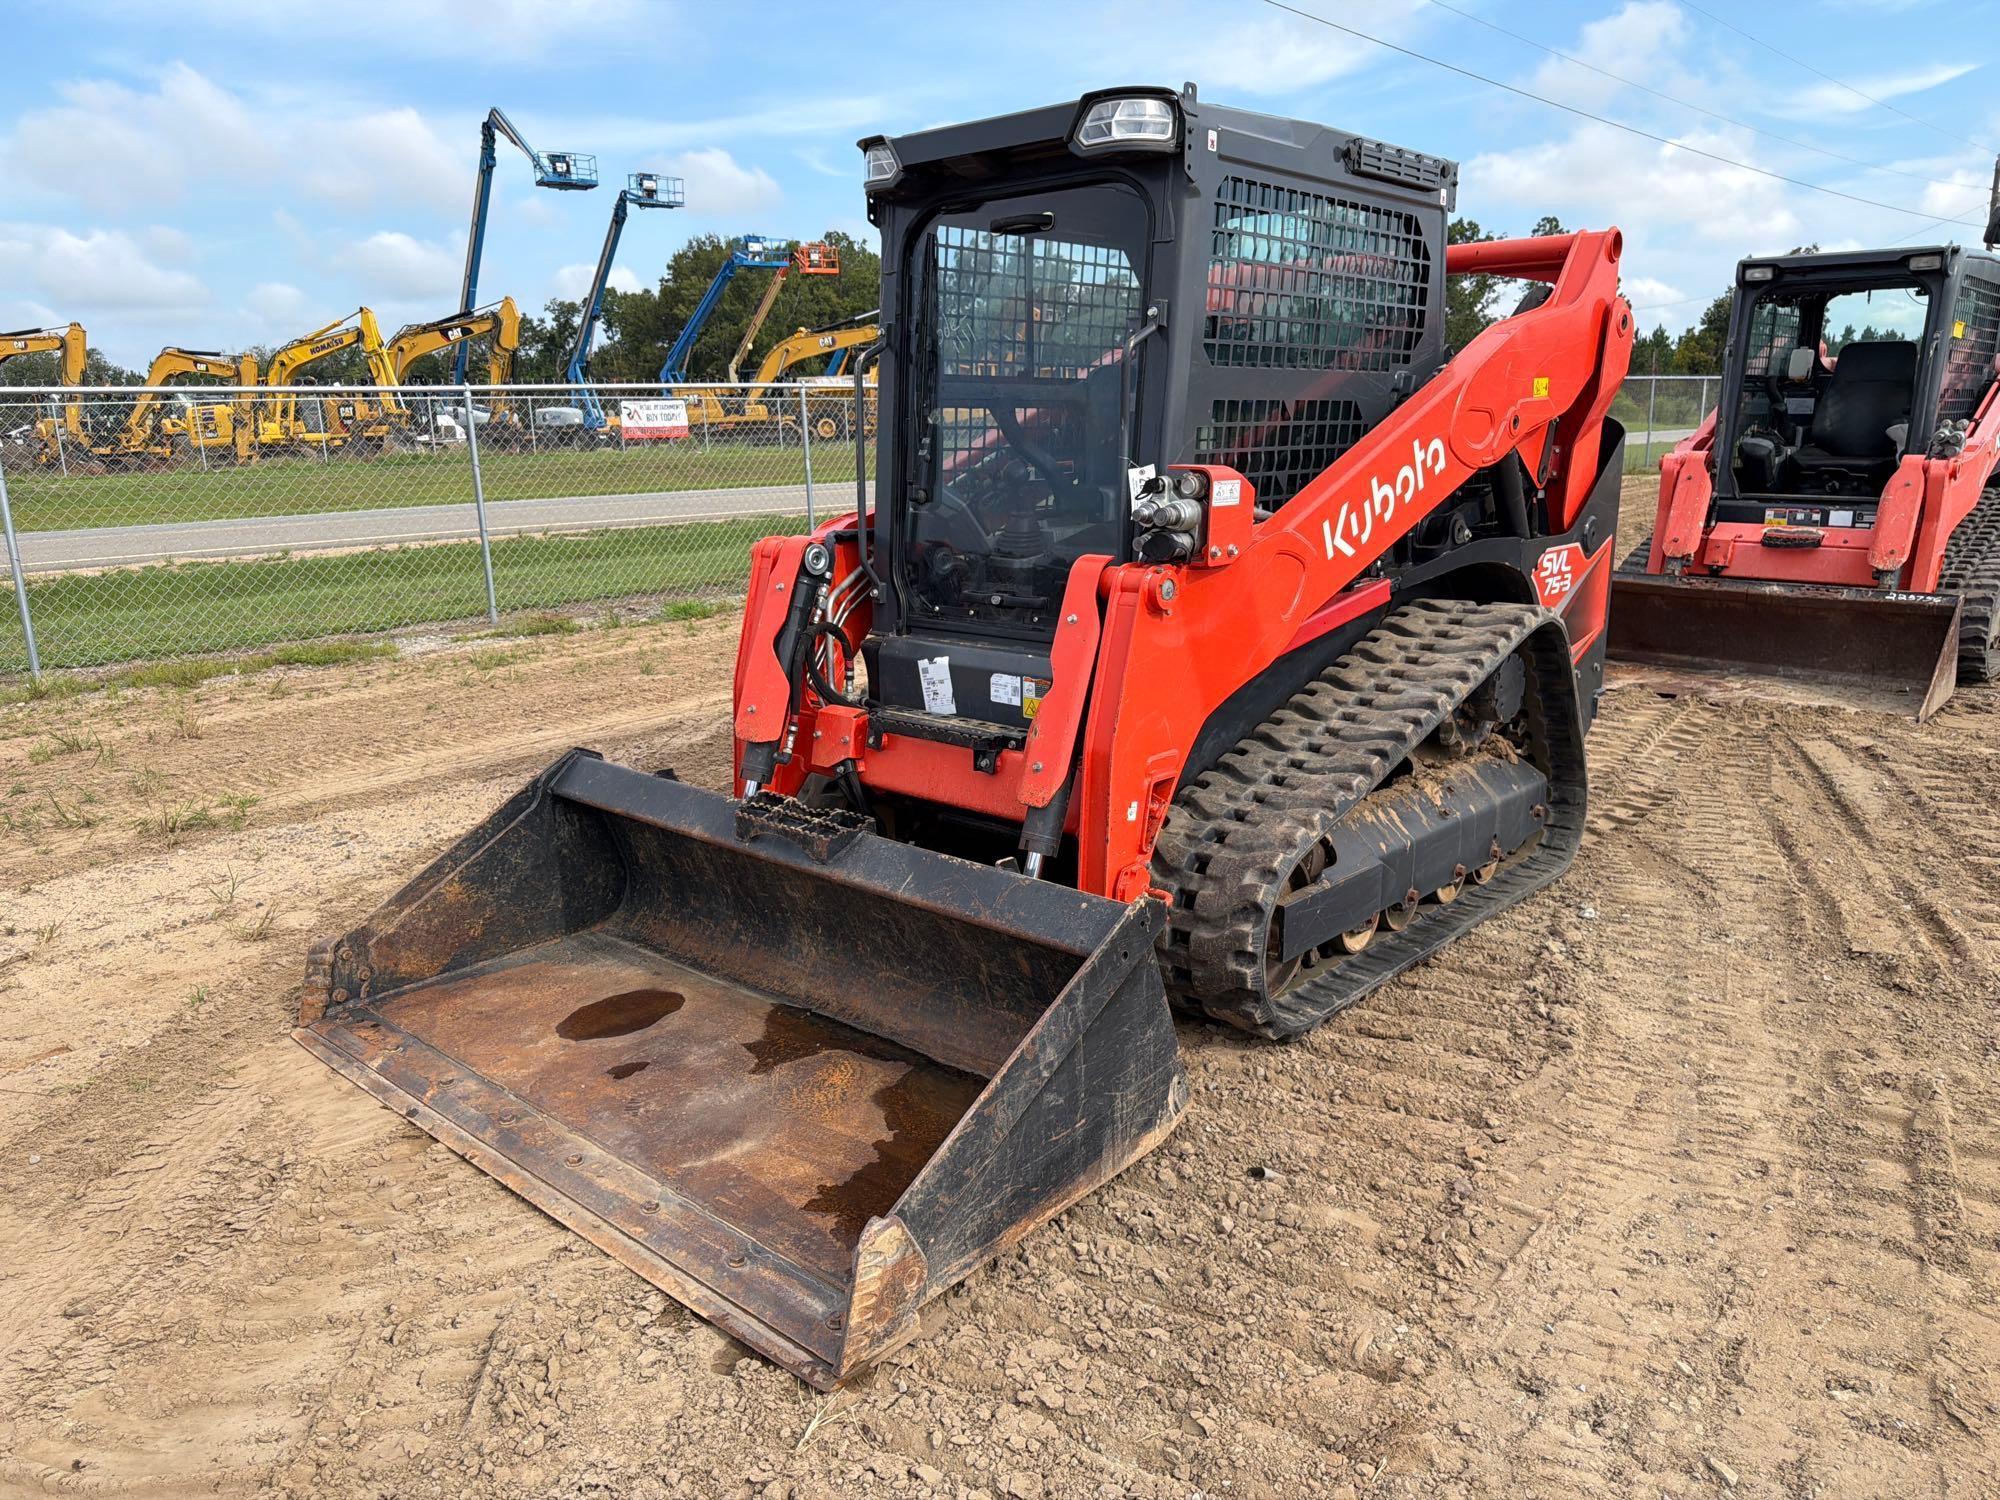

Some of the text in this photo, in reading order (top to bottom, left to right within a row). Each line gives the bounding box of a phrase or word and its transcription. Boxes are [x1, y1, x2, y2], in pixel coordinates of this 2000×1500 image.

[448, 327, 463, 340] CAT
[13, 340, 26, 350] CAT
[309, 337, 345, 355] KOMATSU
[819, 335, 833, 347] CAT
[196, 362, 207, 371] CAT
[340, 406, 354, 418] CAT
[1322, 438, 1446, 561] Kubota
[1540, 550, 1572, 578] SVL
[1544, 573, 1572, 597] 75-3
